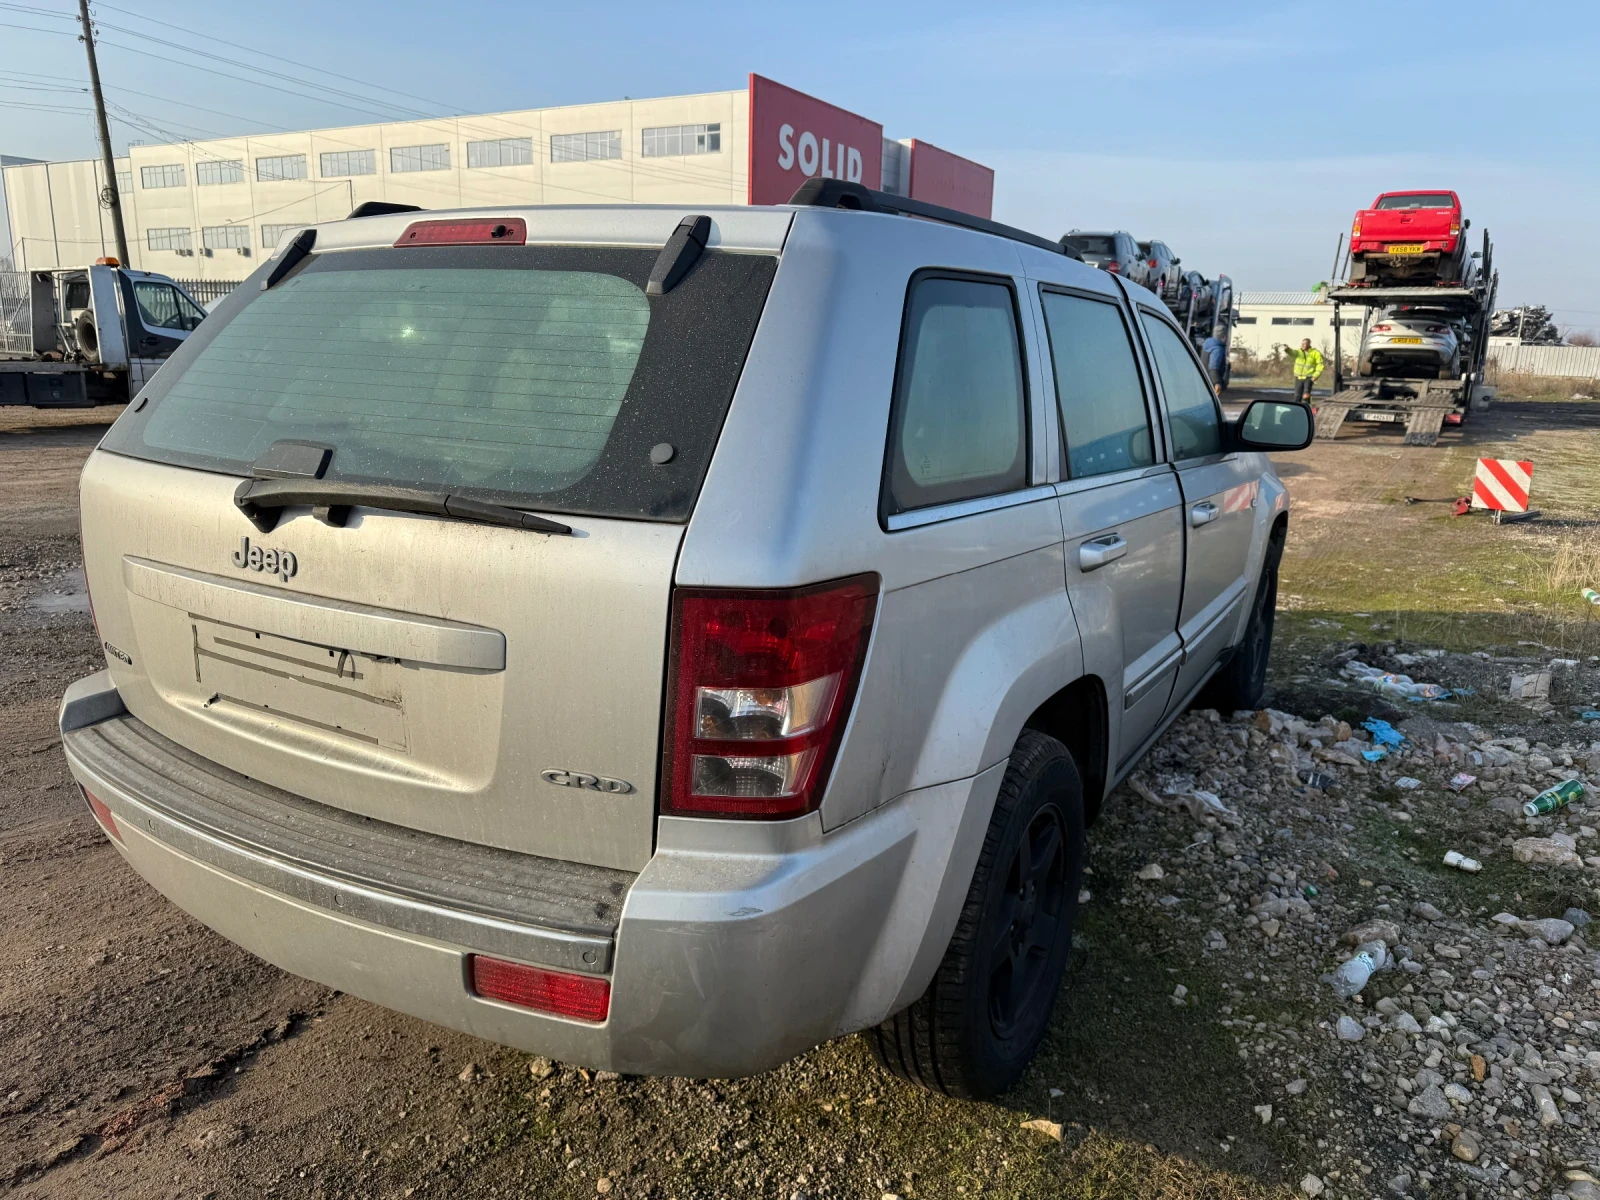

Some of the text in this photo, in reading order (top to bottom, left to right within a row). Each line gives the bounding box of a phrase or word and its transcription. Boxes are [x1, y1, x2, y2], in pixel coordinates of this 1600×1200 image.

[777, 123, 863, 184] SOLID
[231, 535, 298, 583] Jeep
[540, 768, 634, 794] CRD
